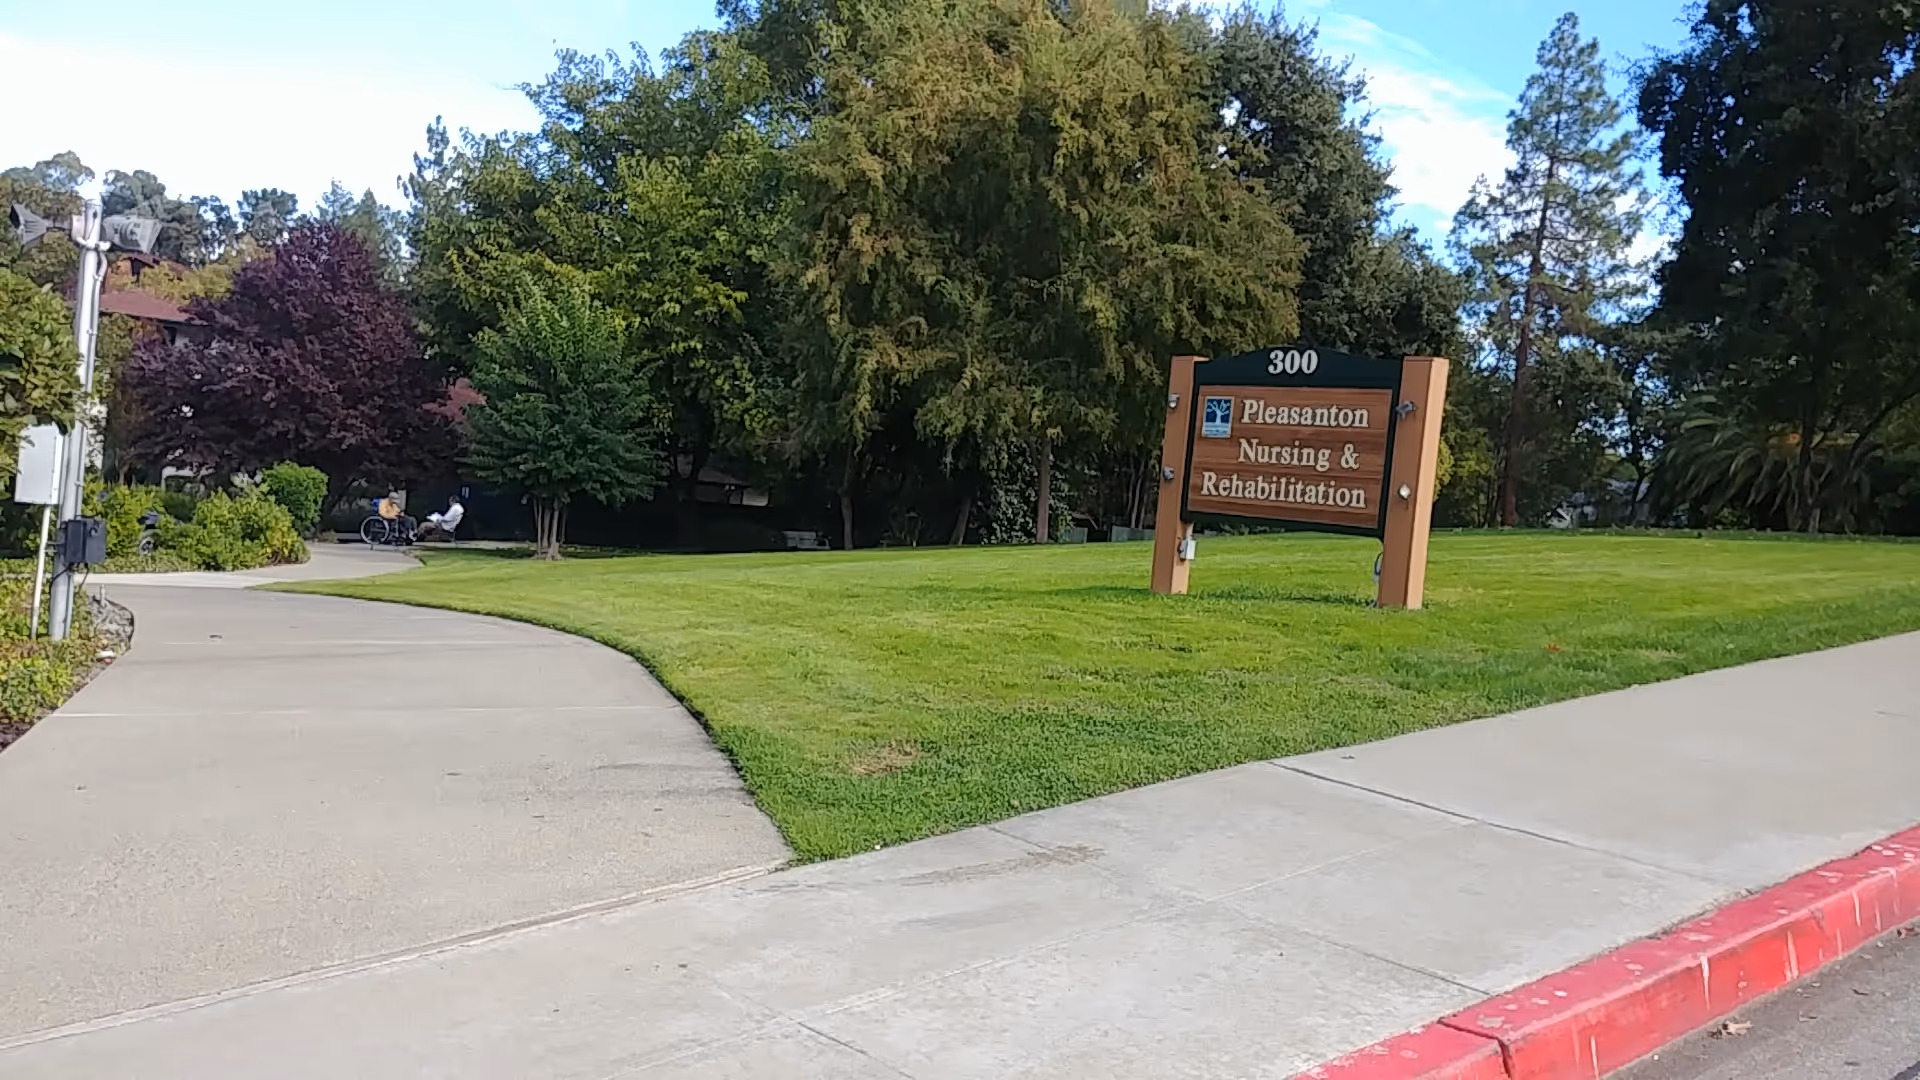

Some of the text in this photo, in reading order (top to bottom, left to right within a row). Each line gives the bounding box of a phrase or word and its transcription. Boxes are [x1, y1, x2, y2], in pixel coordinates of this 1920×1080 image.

[1267, 350, 1318, 374] 300
[1241, 399, 1369, 428] Pleasanton
[1238, 438, 1360, 471] Nursing &
[1201, 472, 1366, 508] Rehabilitation
